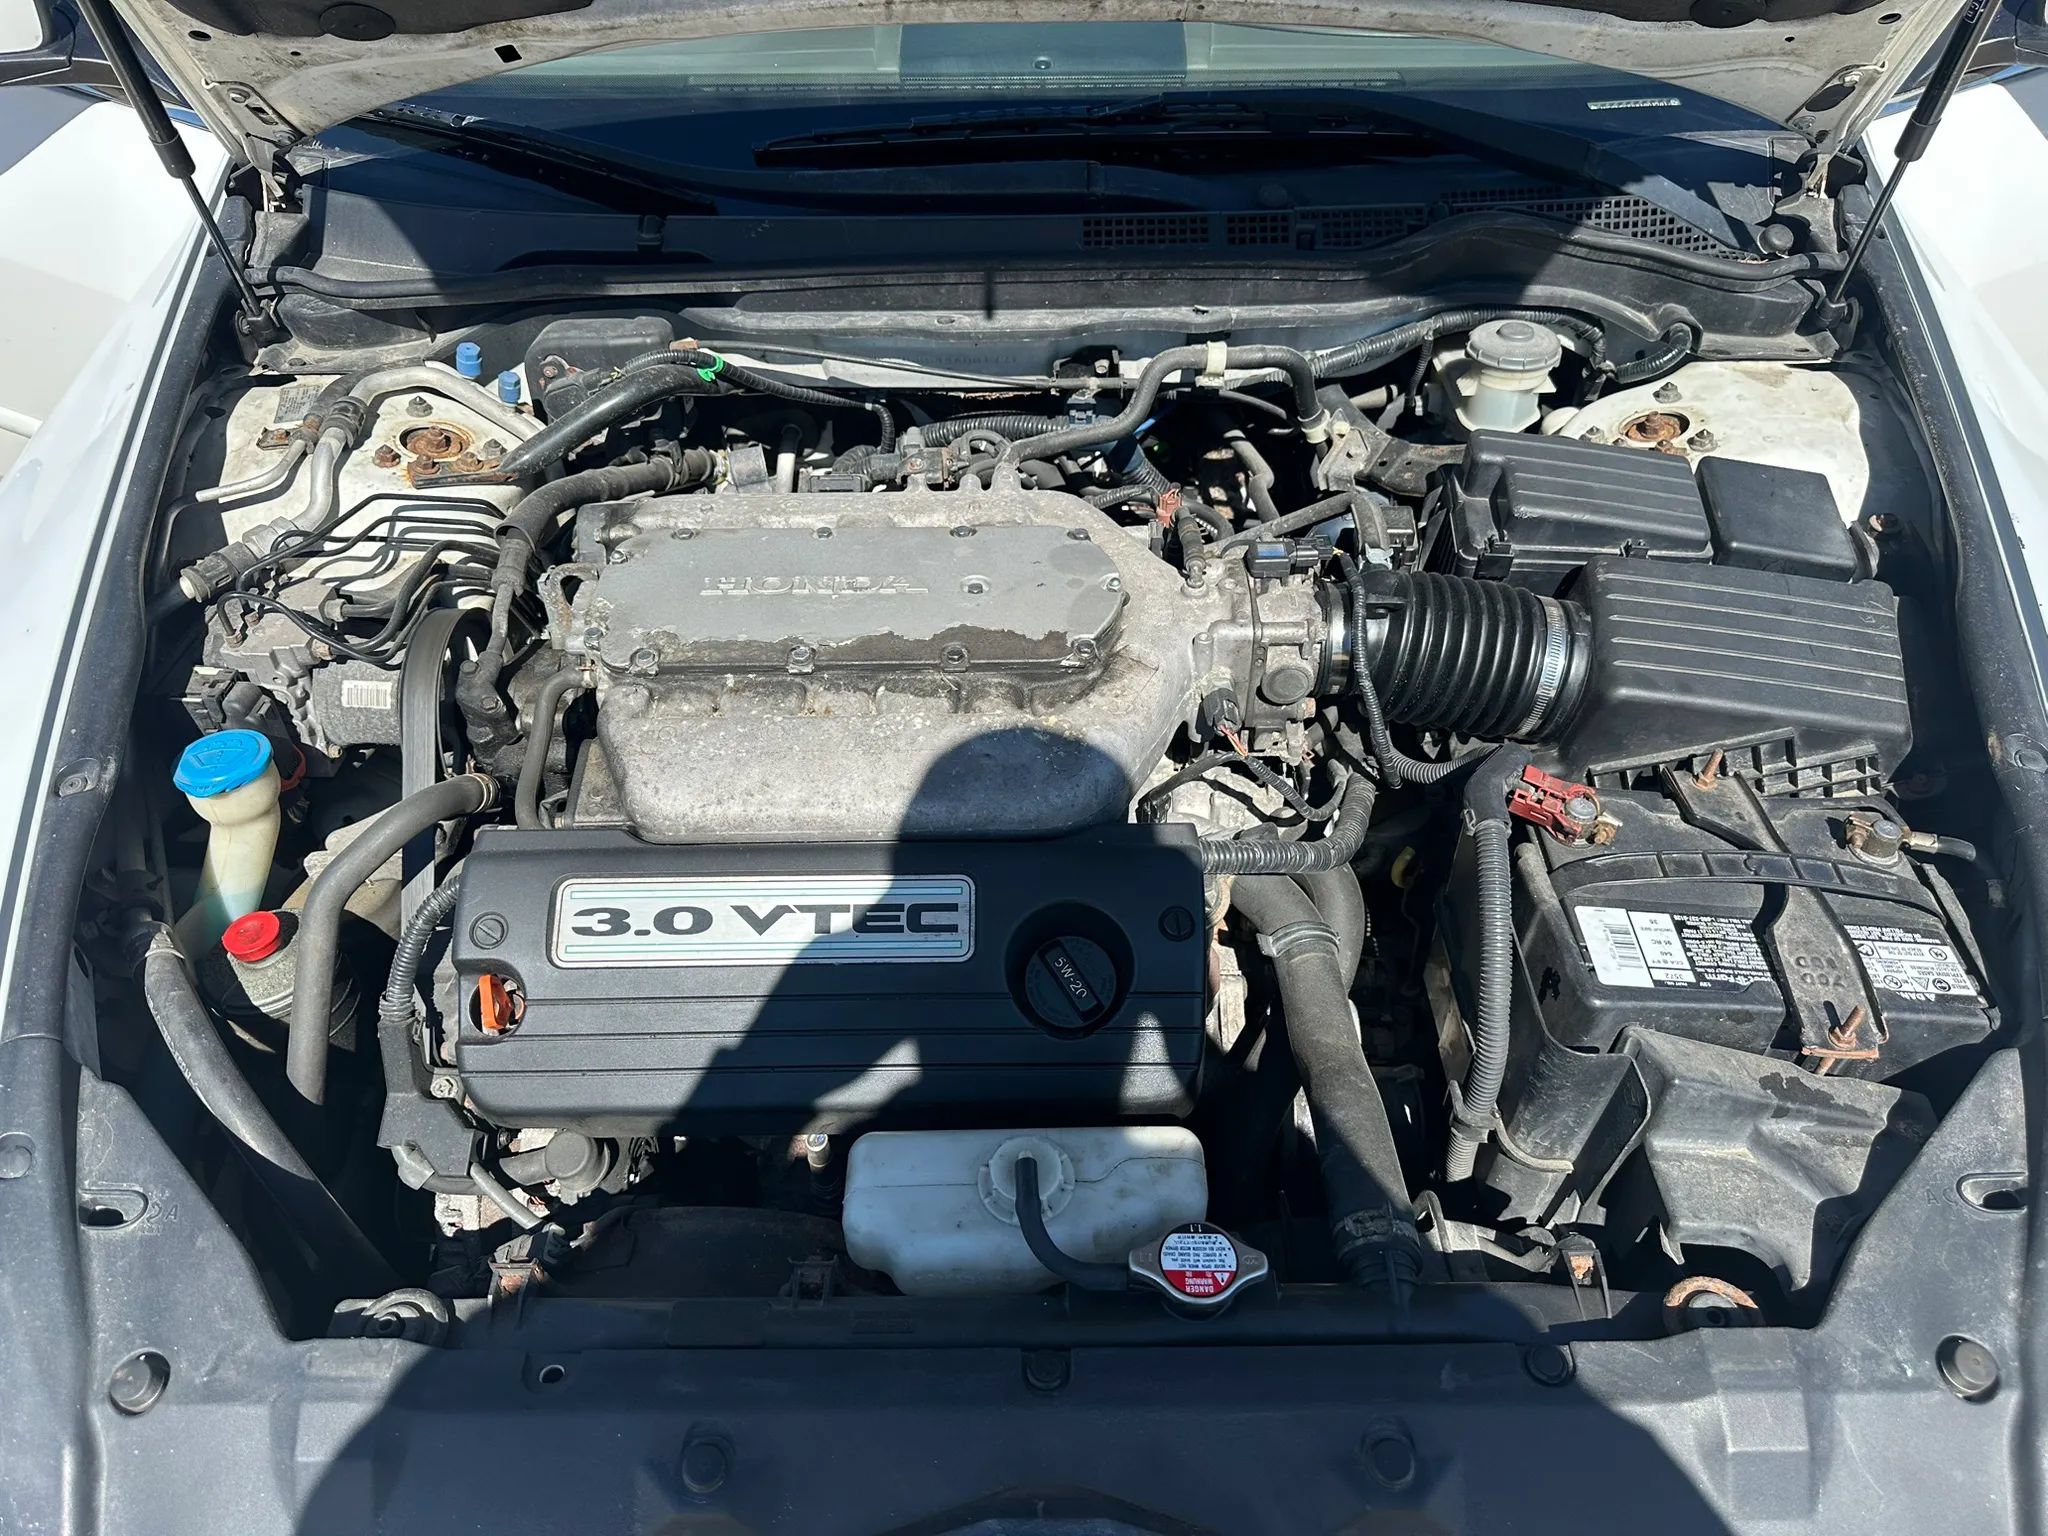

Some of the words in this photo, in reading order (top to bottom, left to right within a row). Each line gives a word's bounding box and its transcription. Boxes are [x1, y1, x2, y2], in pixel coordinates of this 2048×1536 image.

[700, 575, 928, 595] HONDA
[571, 905, 715, 937] 3.0
[729, 902, 959, 937] VTEC
[1054, 956, 1088, 998] 5W-20
[1704, 973, 1735, 984] Farm
[1189, 1223, 1202, 1232] 1.1
